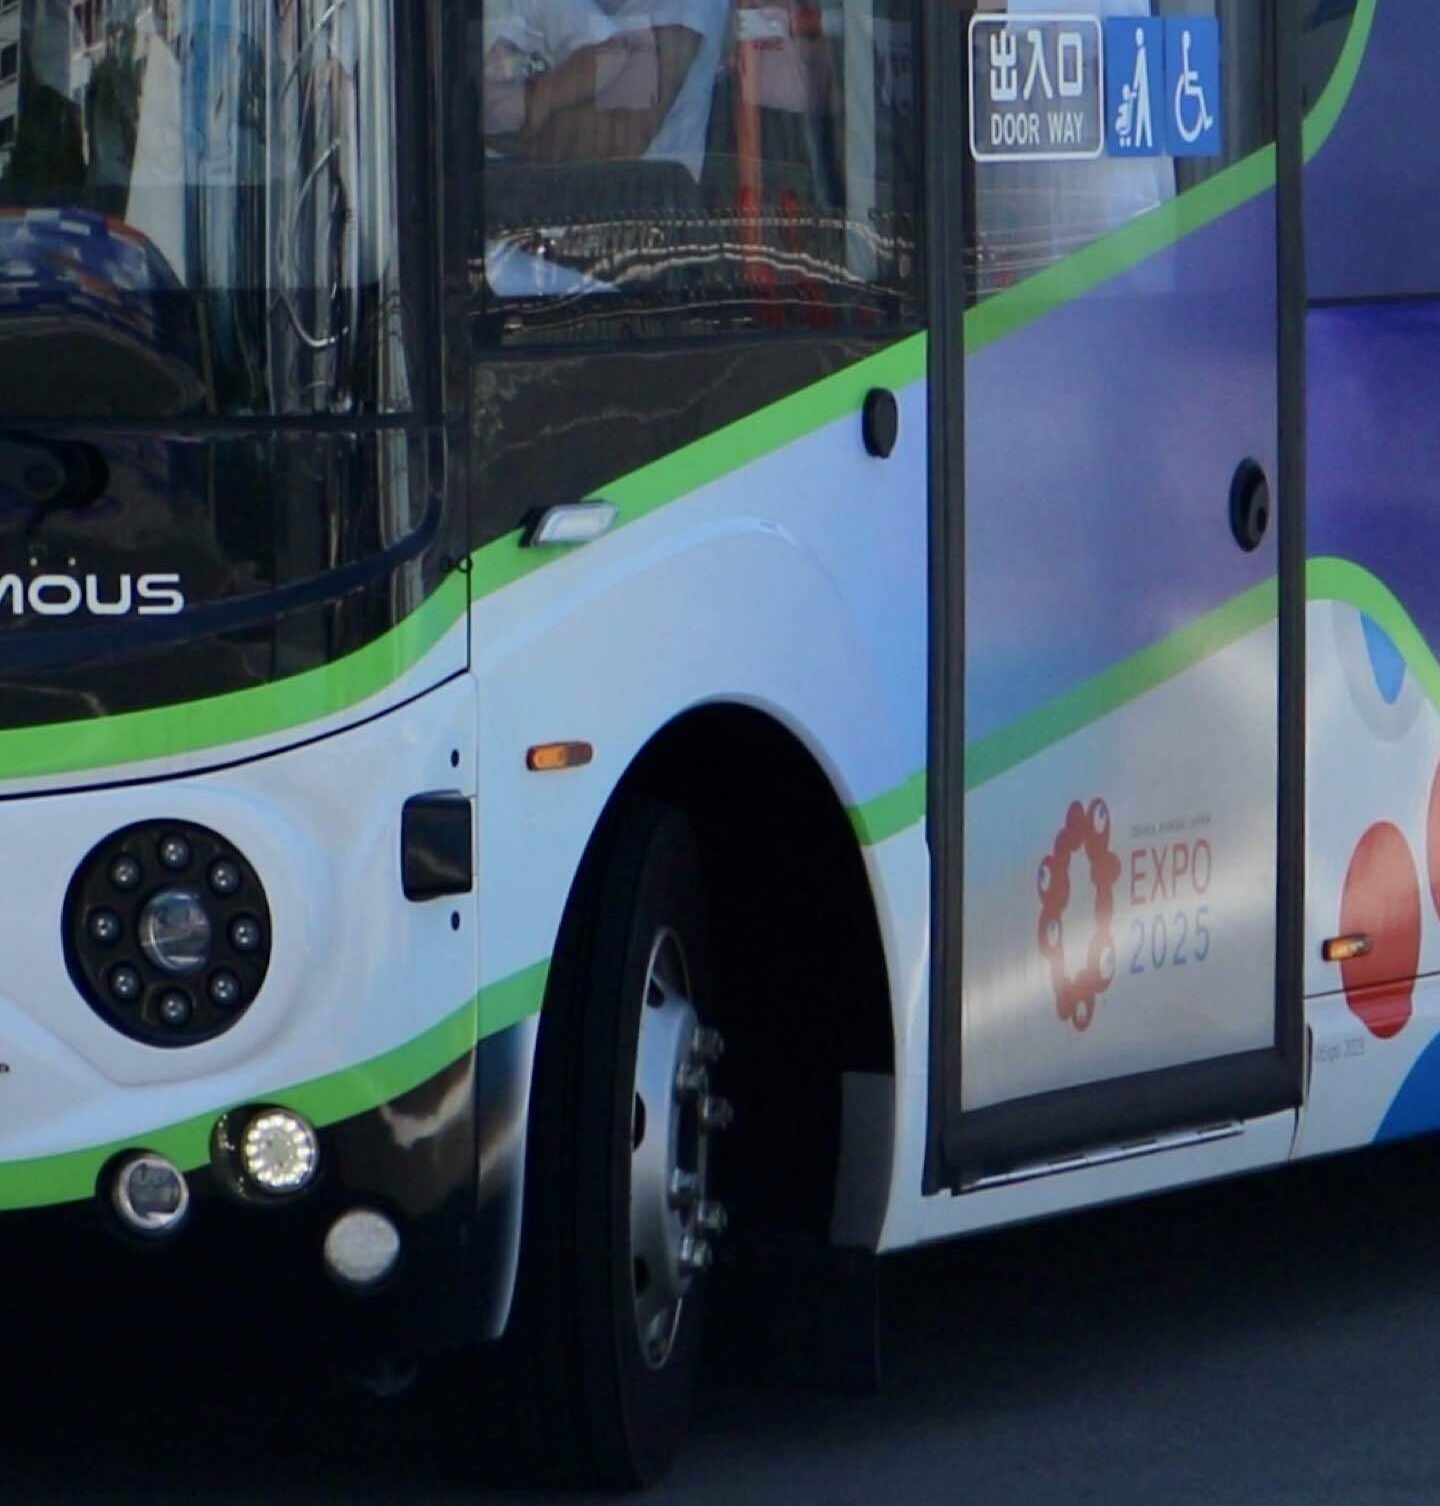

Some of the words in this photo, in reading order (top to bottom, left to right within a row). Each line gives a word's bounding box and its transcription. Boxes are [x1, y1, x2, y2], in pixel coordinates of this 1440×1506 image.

[990, 29, 1083, 101] 出入口
[991, 112, 1040, 145] DOOR
[1046, 111, 1084, 143] WAY
[1130, 838, 1212, 906] EXPO
[1130, 904, 1210, 975] 2025
